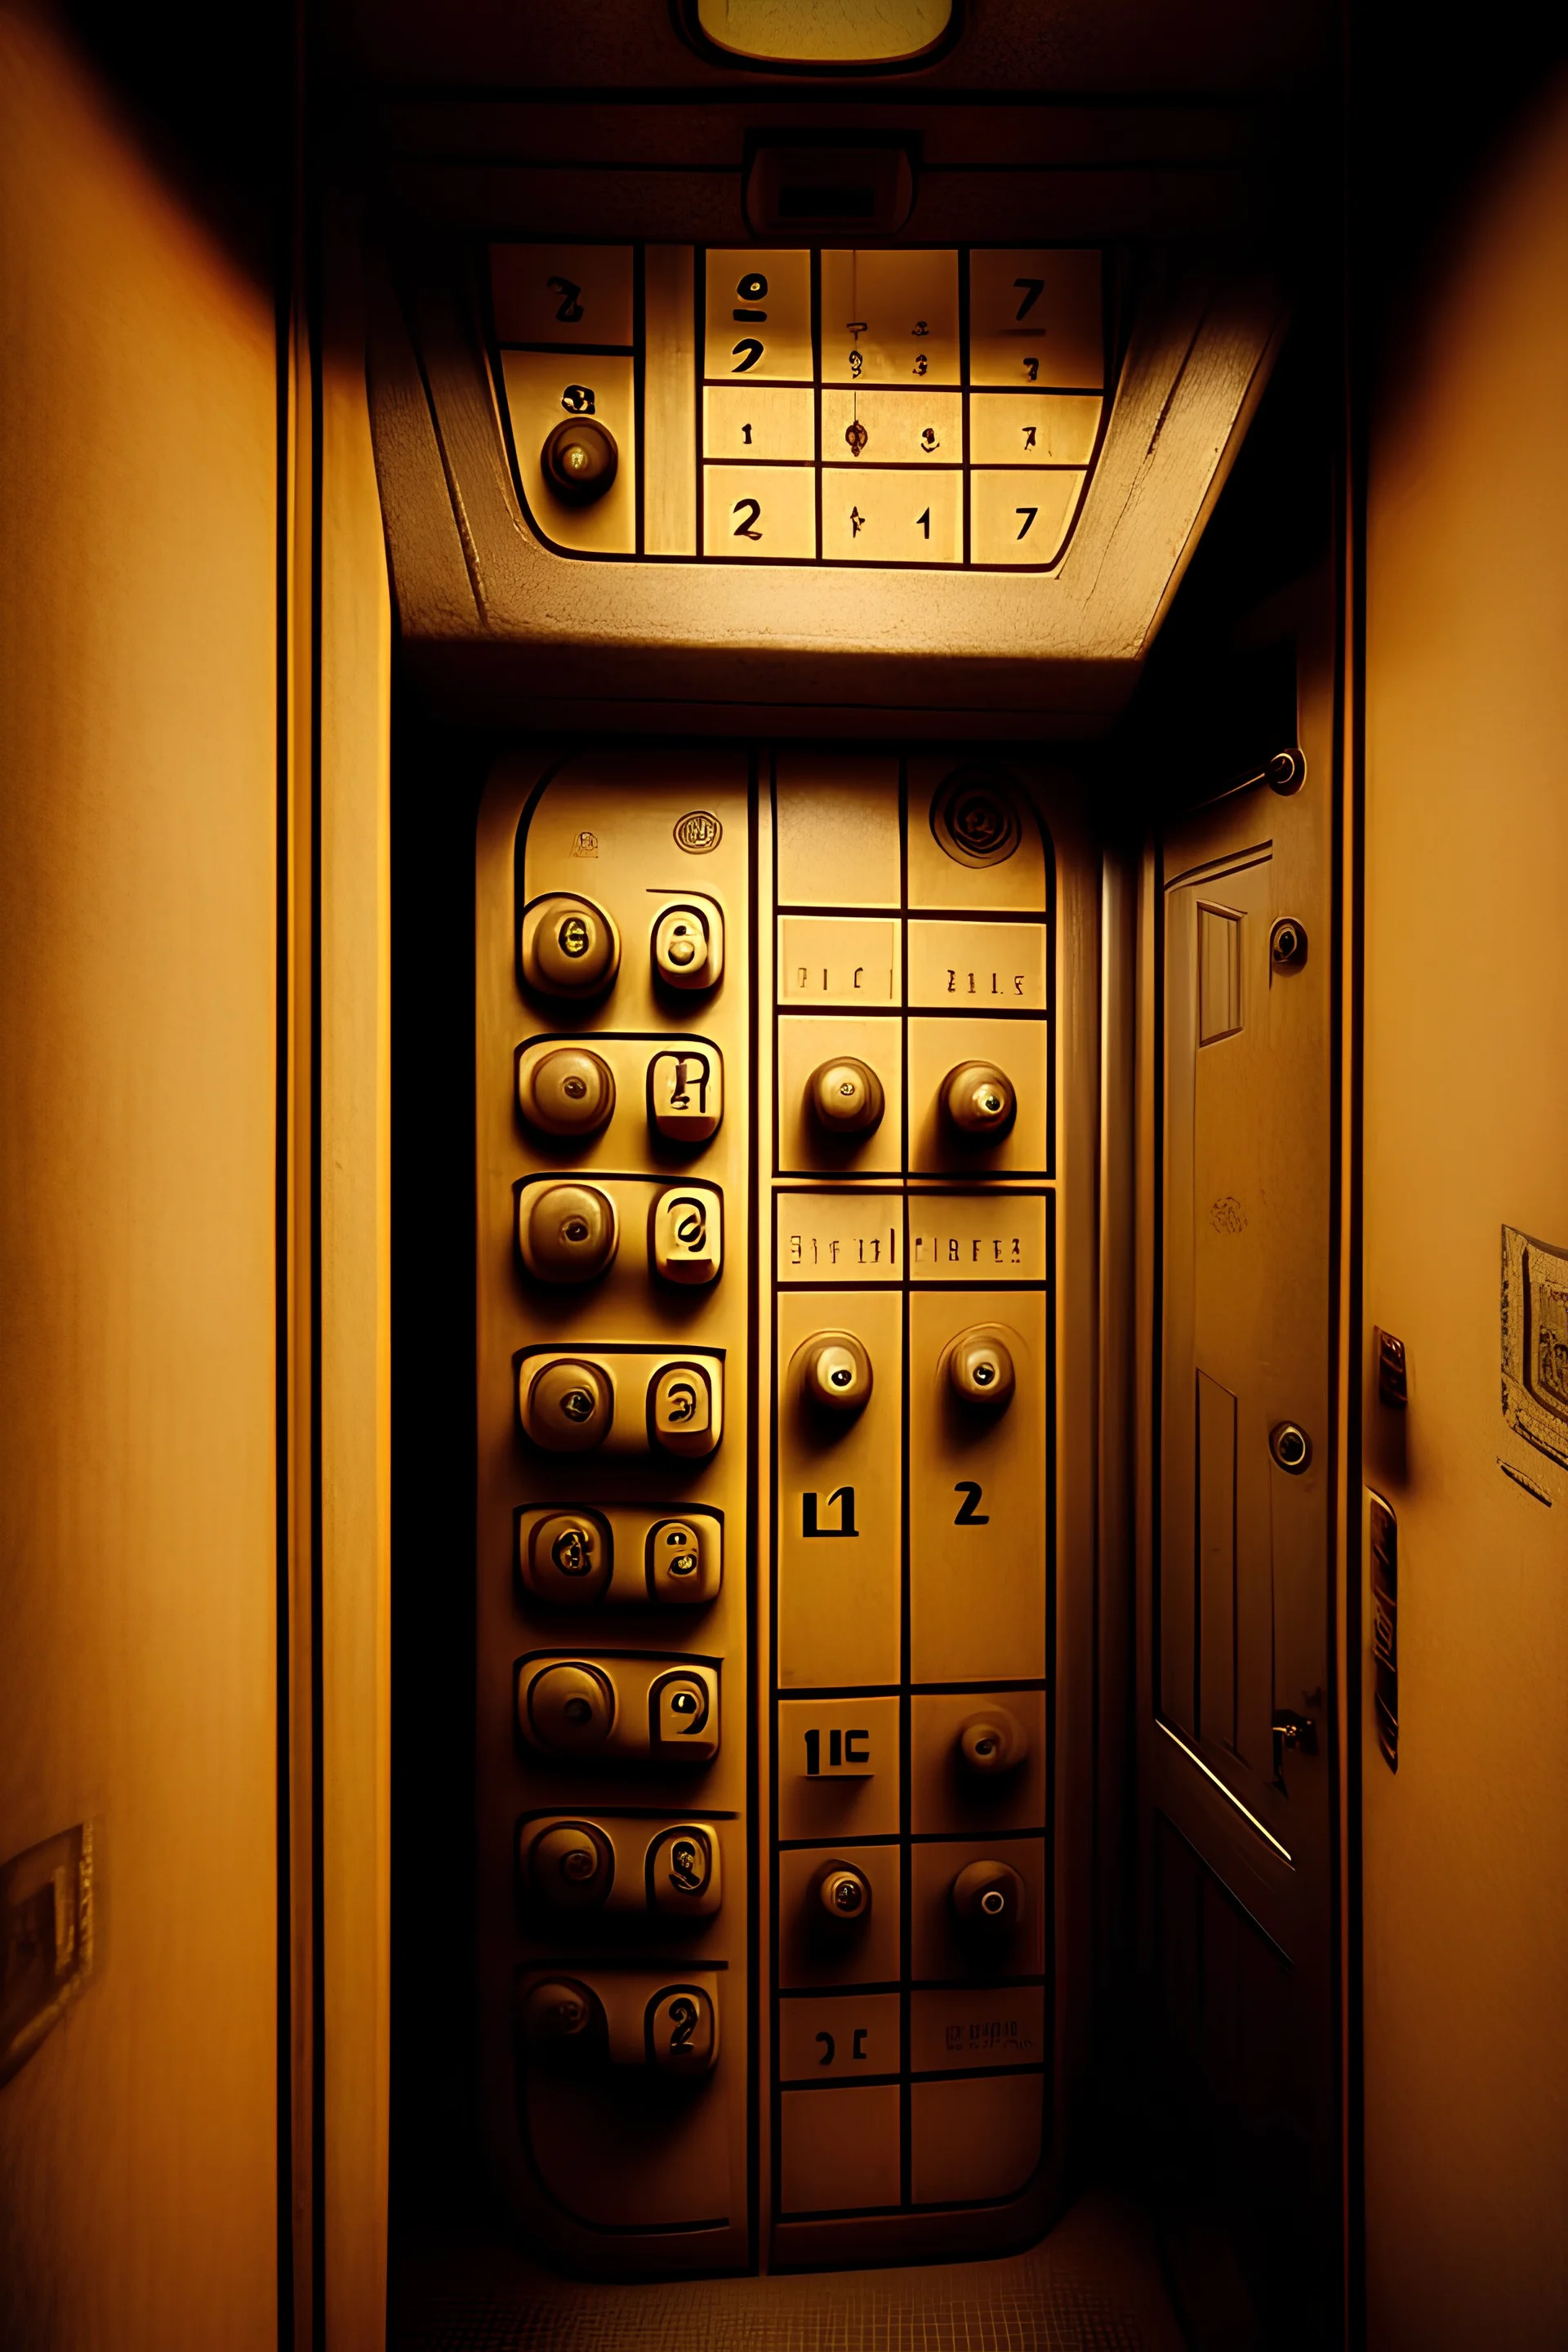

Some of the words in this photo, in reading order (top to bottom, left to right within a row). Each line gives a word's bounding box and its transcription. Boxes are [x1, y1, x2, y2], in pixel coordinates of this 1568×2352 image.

[1013, 278, 1045, 321] 7
[742, 423, 752, 444] 1
[733, 498, 763, 541] 2
[1015, 507, 1038, 540] 7
[954, 1481, 990, 1525] 2
[668, 1996, 698, 2055] 2
